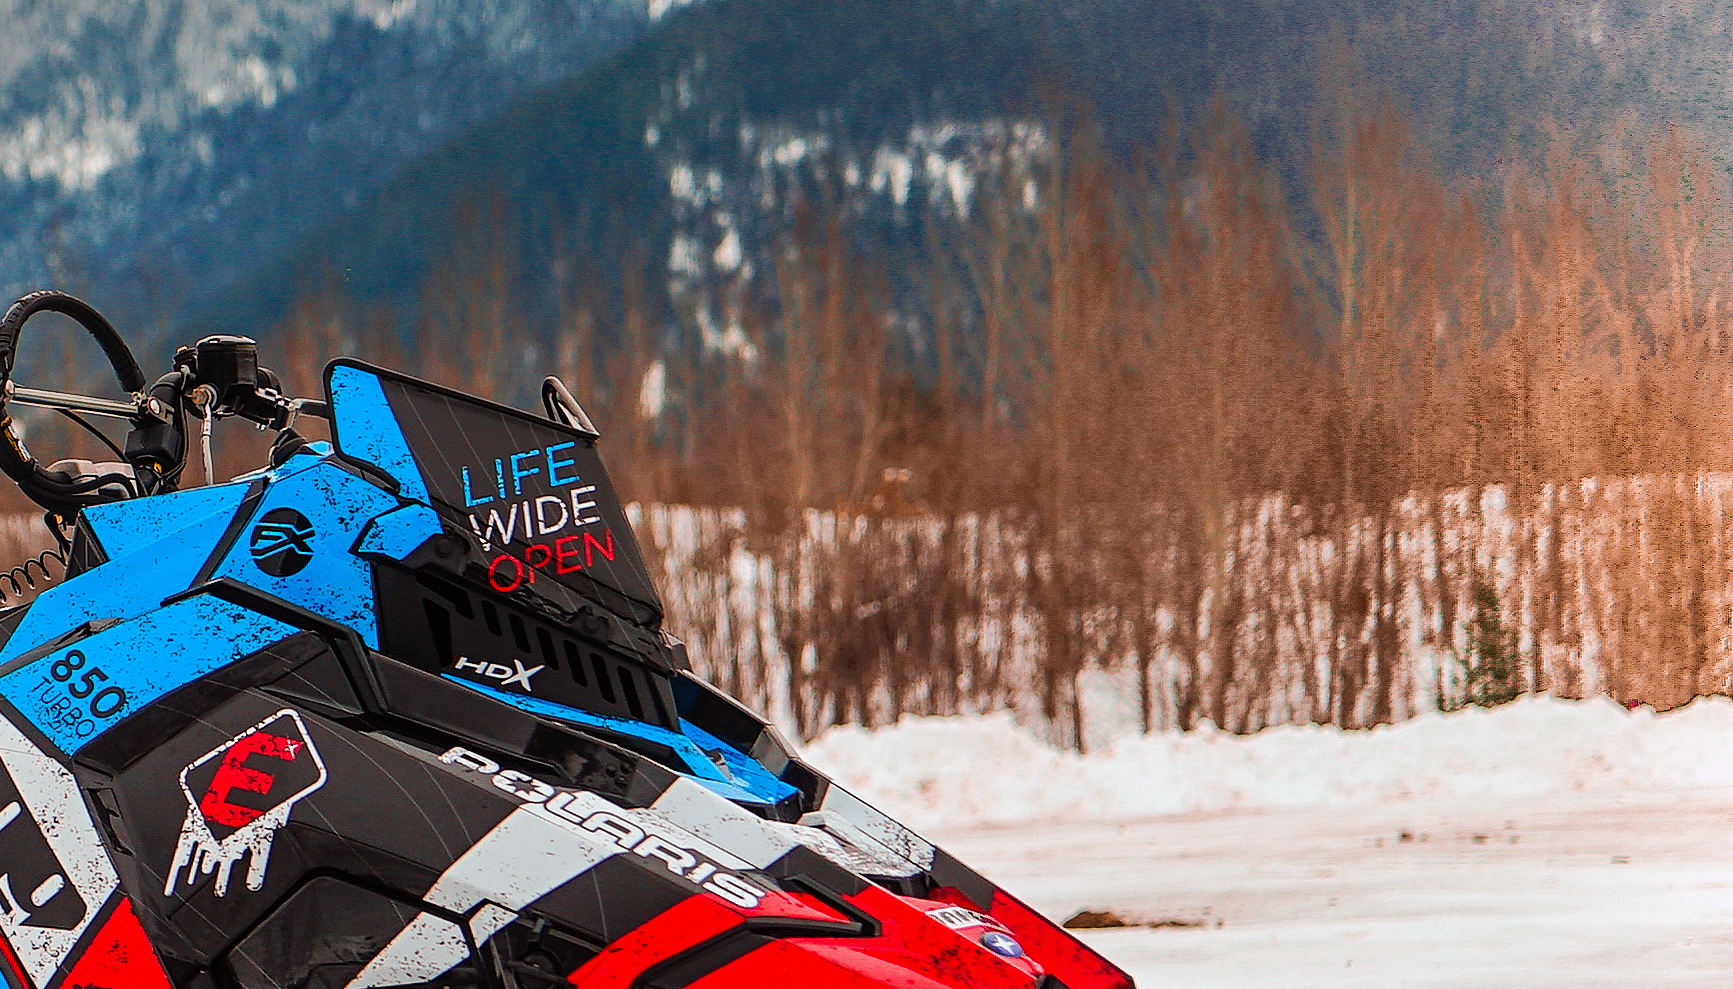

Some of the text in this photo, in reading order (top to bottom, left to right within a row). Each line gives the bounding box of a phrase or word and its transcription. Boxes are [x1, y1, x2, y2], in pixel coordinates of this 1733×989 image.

[461, 441, 580, 507] LIFE
[469, 485, 601, 551] WIDE
[488, 527, 615, 592] OPEN
[31, 675, 95, 738] TURBO
[50, 649, 127, 718] 850
[454, 656, 545, 692] HDX
[436, 746, 767, 909] POLARIS
